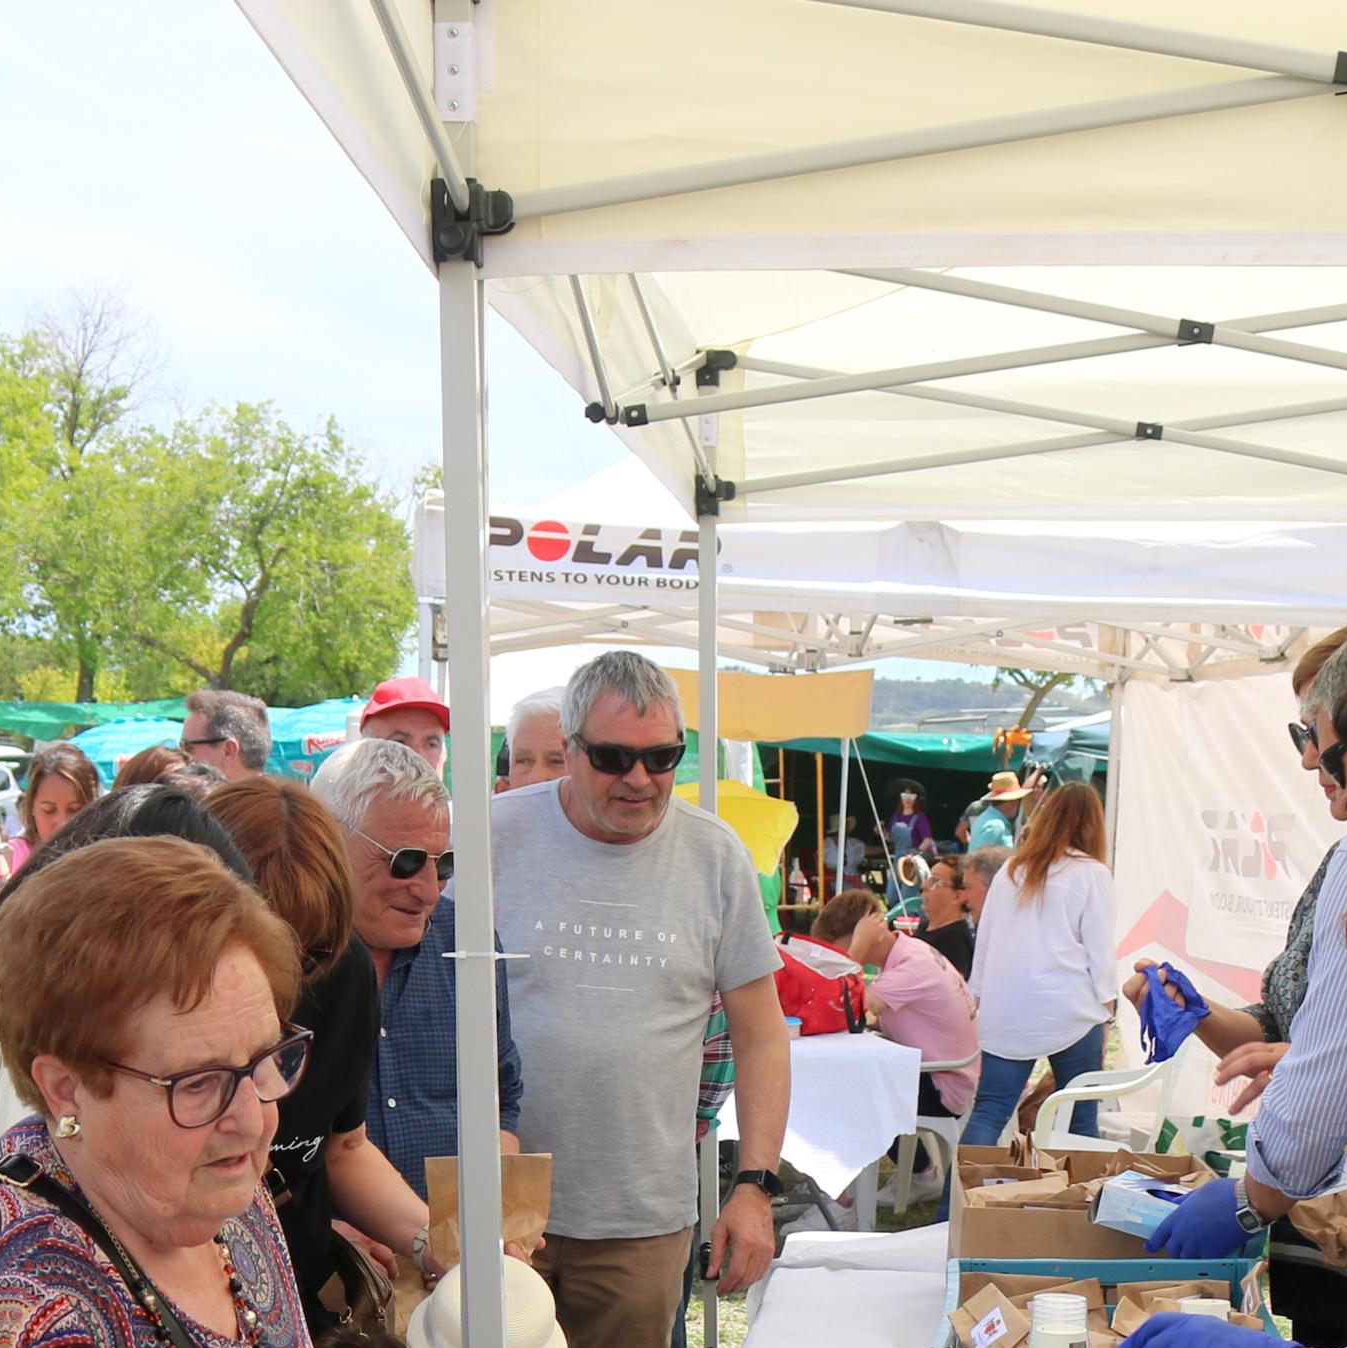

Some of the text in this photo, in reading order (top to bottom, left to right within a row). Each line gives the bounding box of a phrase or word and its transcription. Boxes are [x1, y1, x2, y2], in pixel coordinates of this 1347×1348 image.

[562, 572, 588, 585] TO
[594, 574, 649, 588] YOUR
[656, 578, 699, 590] BOD
[534, 920, 677, 943] A FUTURE OF
[543, 946, 668, 968] CERTAINTY
